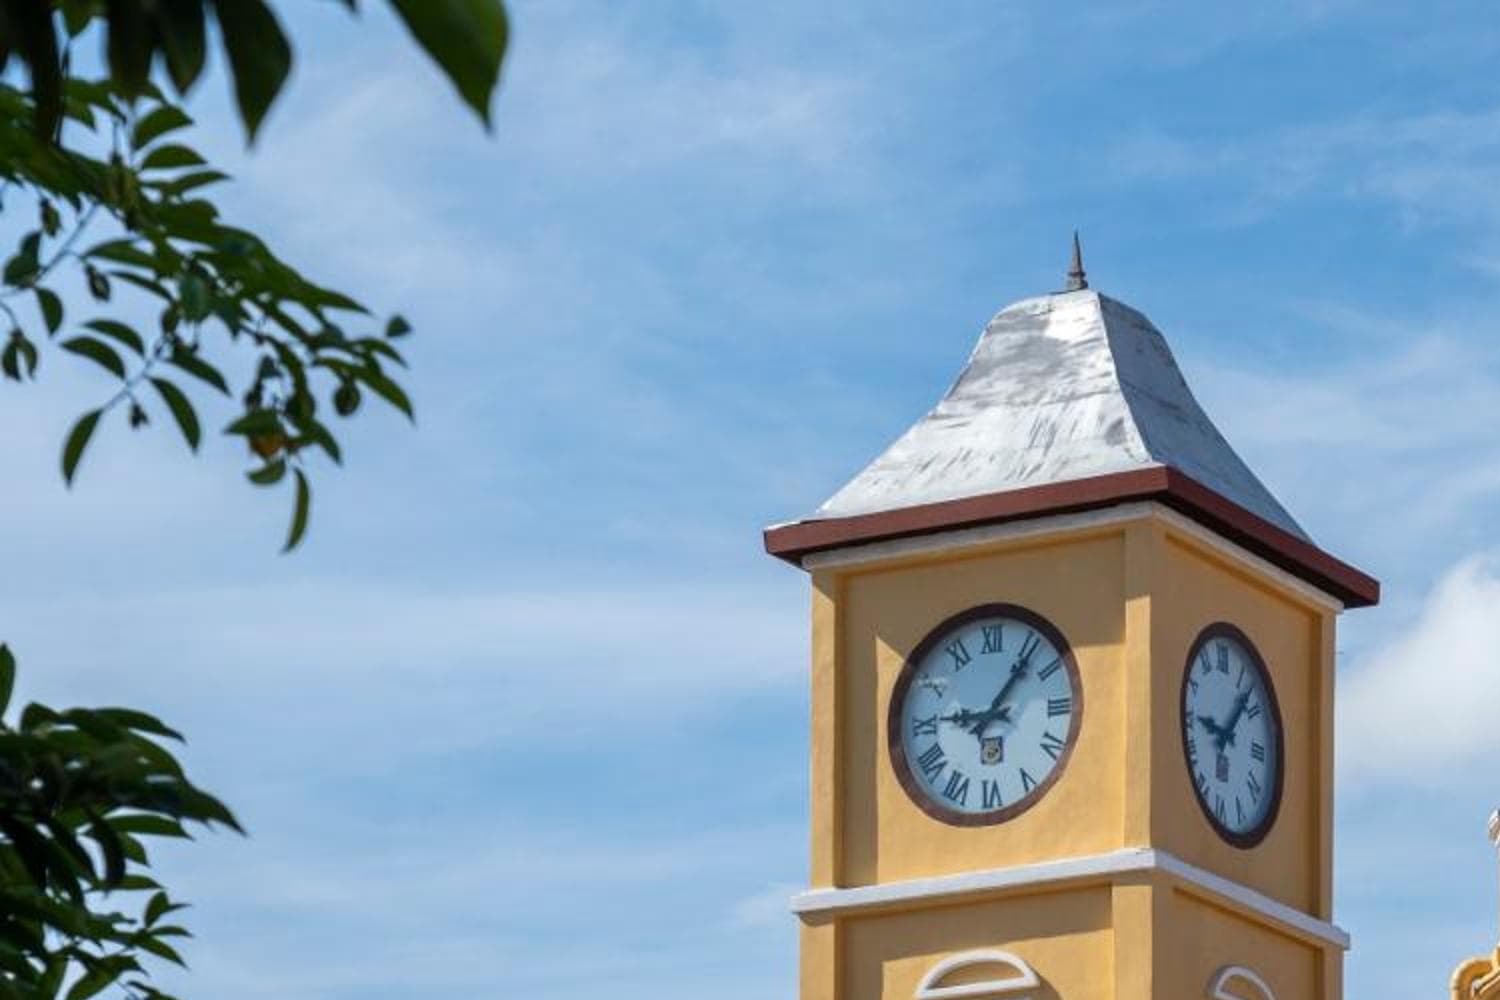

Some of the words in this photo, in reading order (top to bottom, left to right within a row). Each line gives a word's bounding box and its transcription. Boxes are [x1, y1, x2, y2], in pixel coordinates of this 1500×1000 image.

[981, 624, 1004, 654] XII
[945, 638, 972, 672] XI
[1037, 657, 1062, 682] II
[1047, 698, 1073, 717] III
[912, 714, 938, 737] IX
[1039, 731, 1067, 761] IV
[942, 770, 970, 807] VII
[981, 779, 1003, 808] VI
[1019, 767, 1037, 793] V
